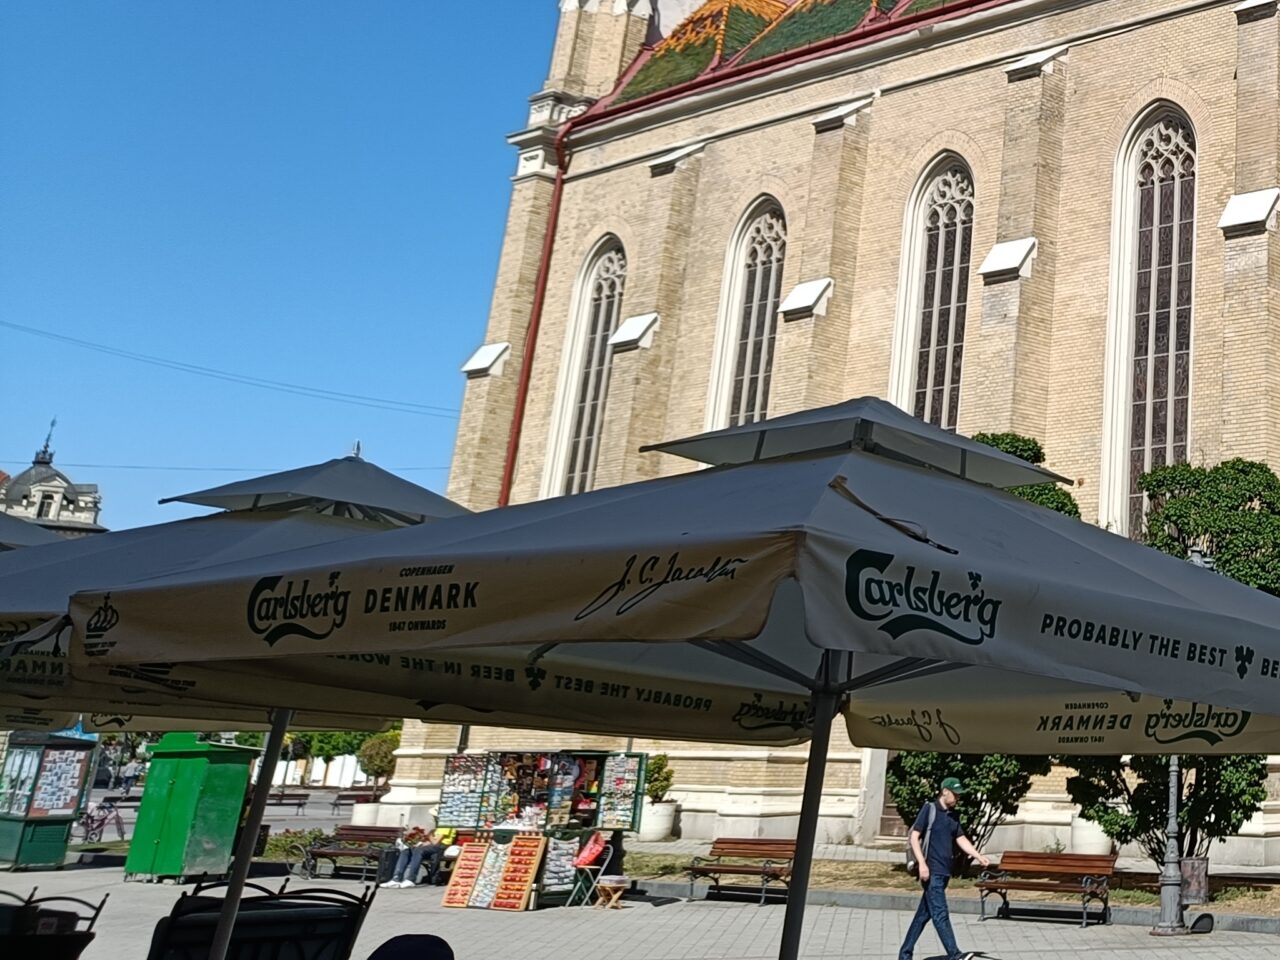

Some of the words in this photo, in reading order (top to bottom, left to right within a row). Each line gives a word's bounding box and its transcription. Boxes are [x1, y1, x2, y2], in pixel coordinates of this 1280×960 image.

[399, 565, 455, 578] COPENHAGEN
[247, 575, 351, 643] Carlsberg
[364, 581, 480, 614] DENMARK
[845, 548, 1002, 643] Carlsberg
[389, 620, 406, 633] 1847
[408, 619, 446, 632] ONWARDS
[1040, 613, 1143, 652] PROBABLY
[1149, 634, 1181, 659] THE
[1186, 642, 1228, 668] BEST
